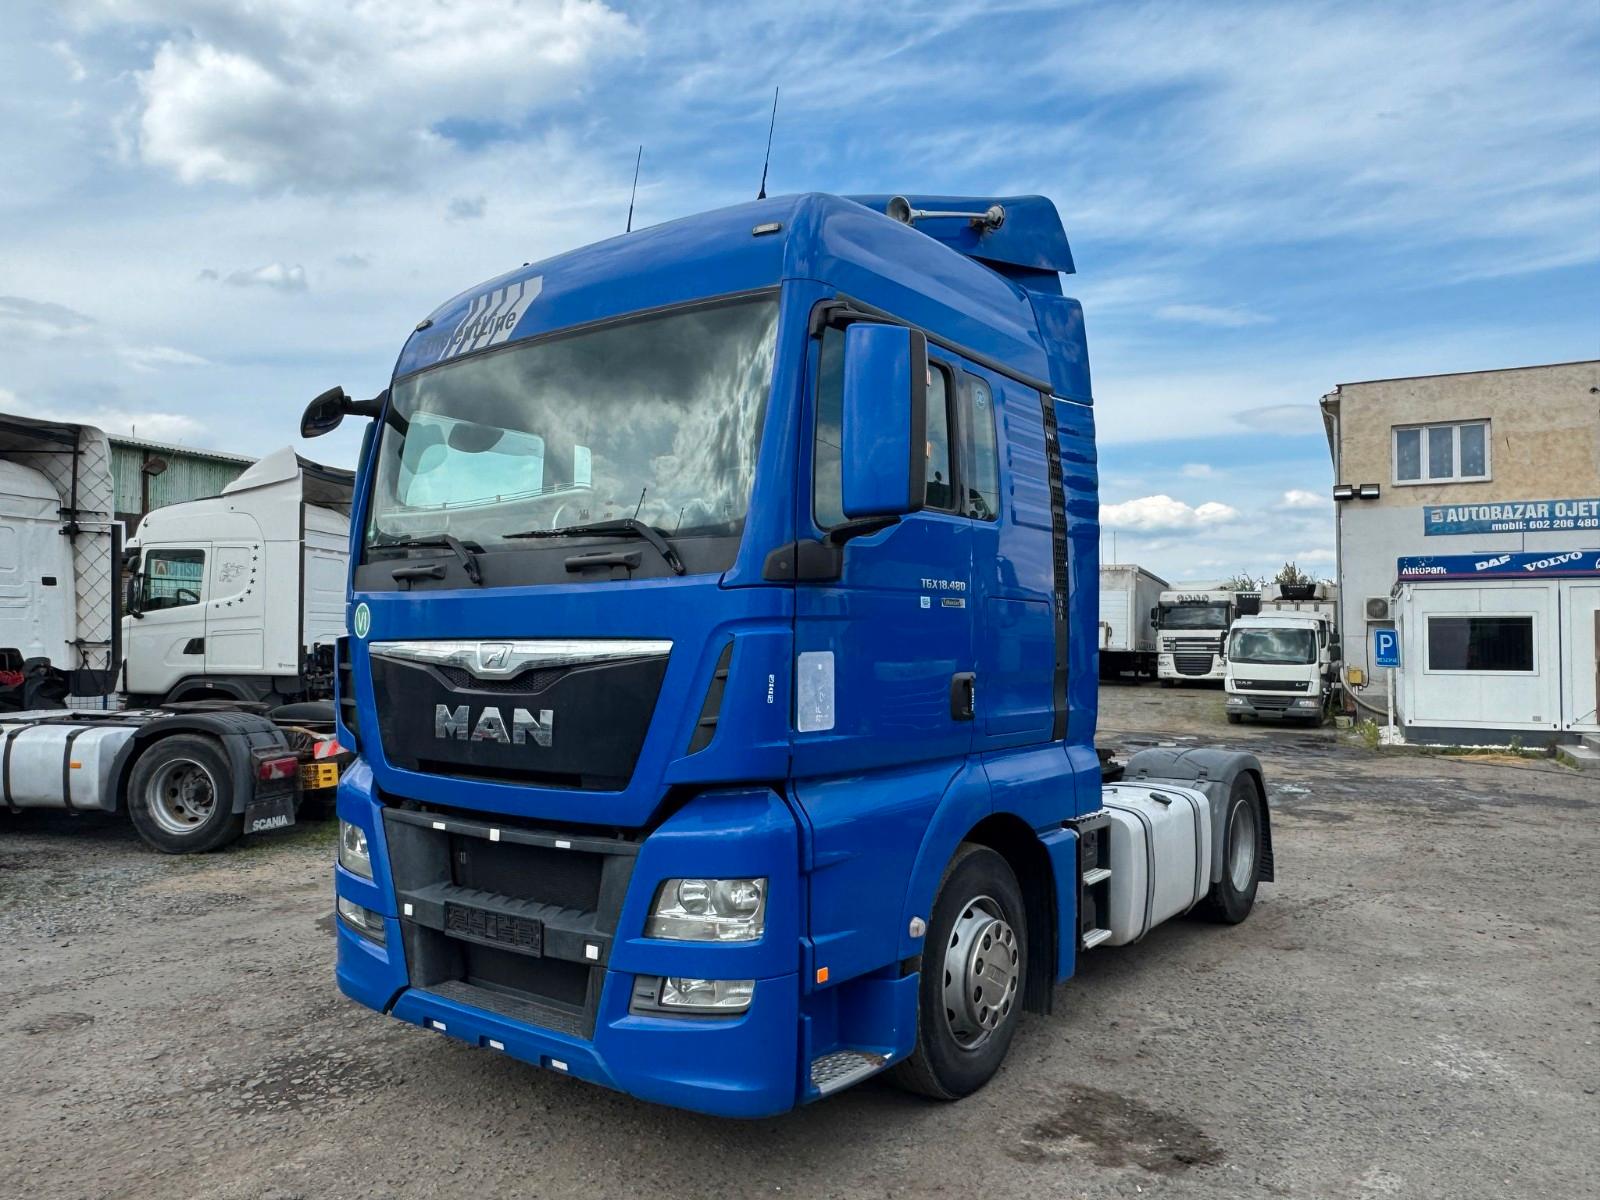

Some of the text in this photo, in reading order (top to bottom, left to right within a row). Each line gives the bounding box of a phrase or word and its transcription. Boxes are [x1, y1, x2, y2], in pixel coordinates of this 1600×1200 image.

[1446, 501, 1599, 523] AUTOBAZAR OJET
[1529, 520, 1550, 529] 602
[1553, 519, 1574, 528] 206
[1577, 518, 1599, 527] 480
[1475, 555, 1511, 571] DAF
[1523, 551, 1583, 572] VOLVO
[1380, 634, 1393, 655] P
[435, 704, 554, 747] MAN
[252, 815, 288, 831] SCANIA
